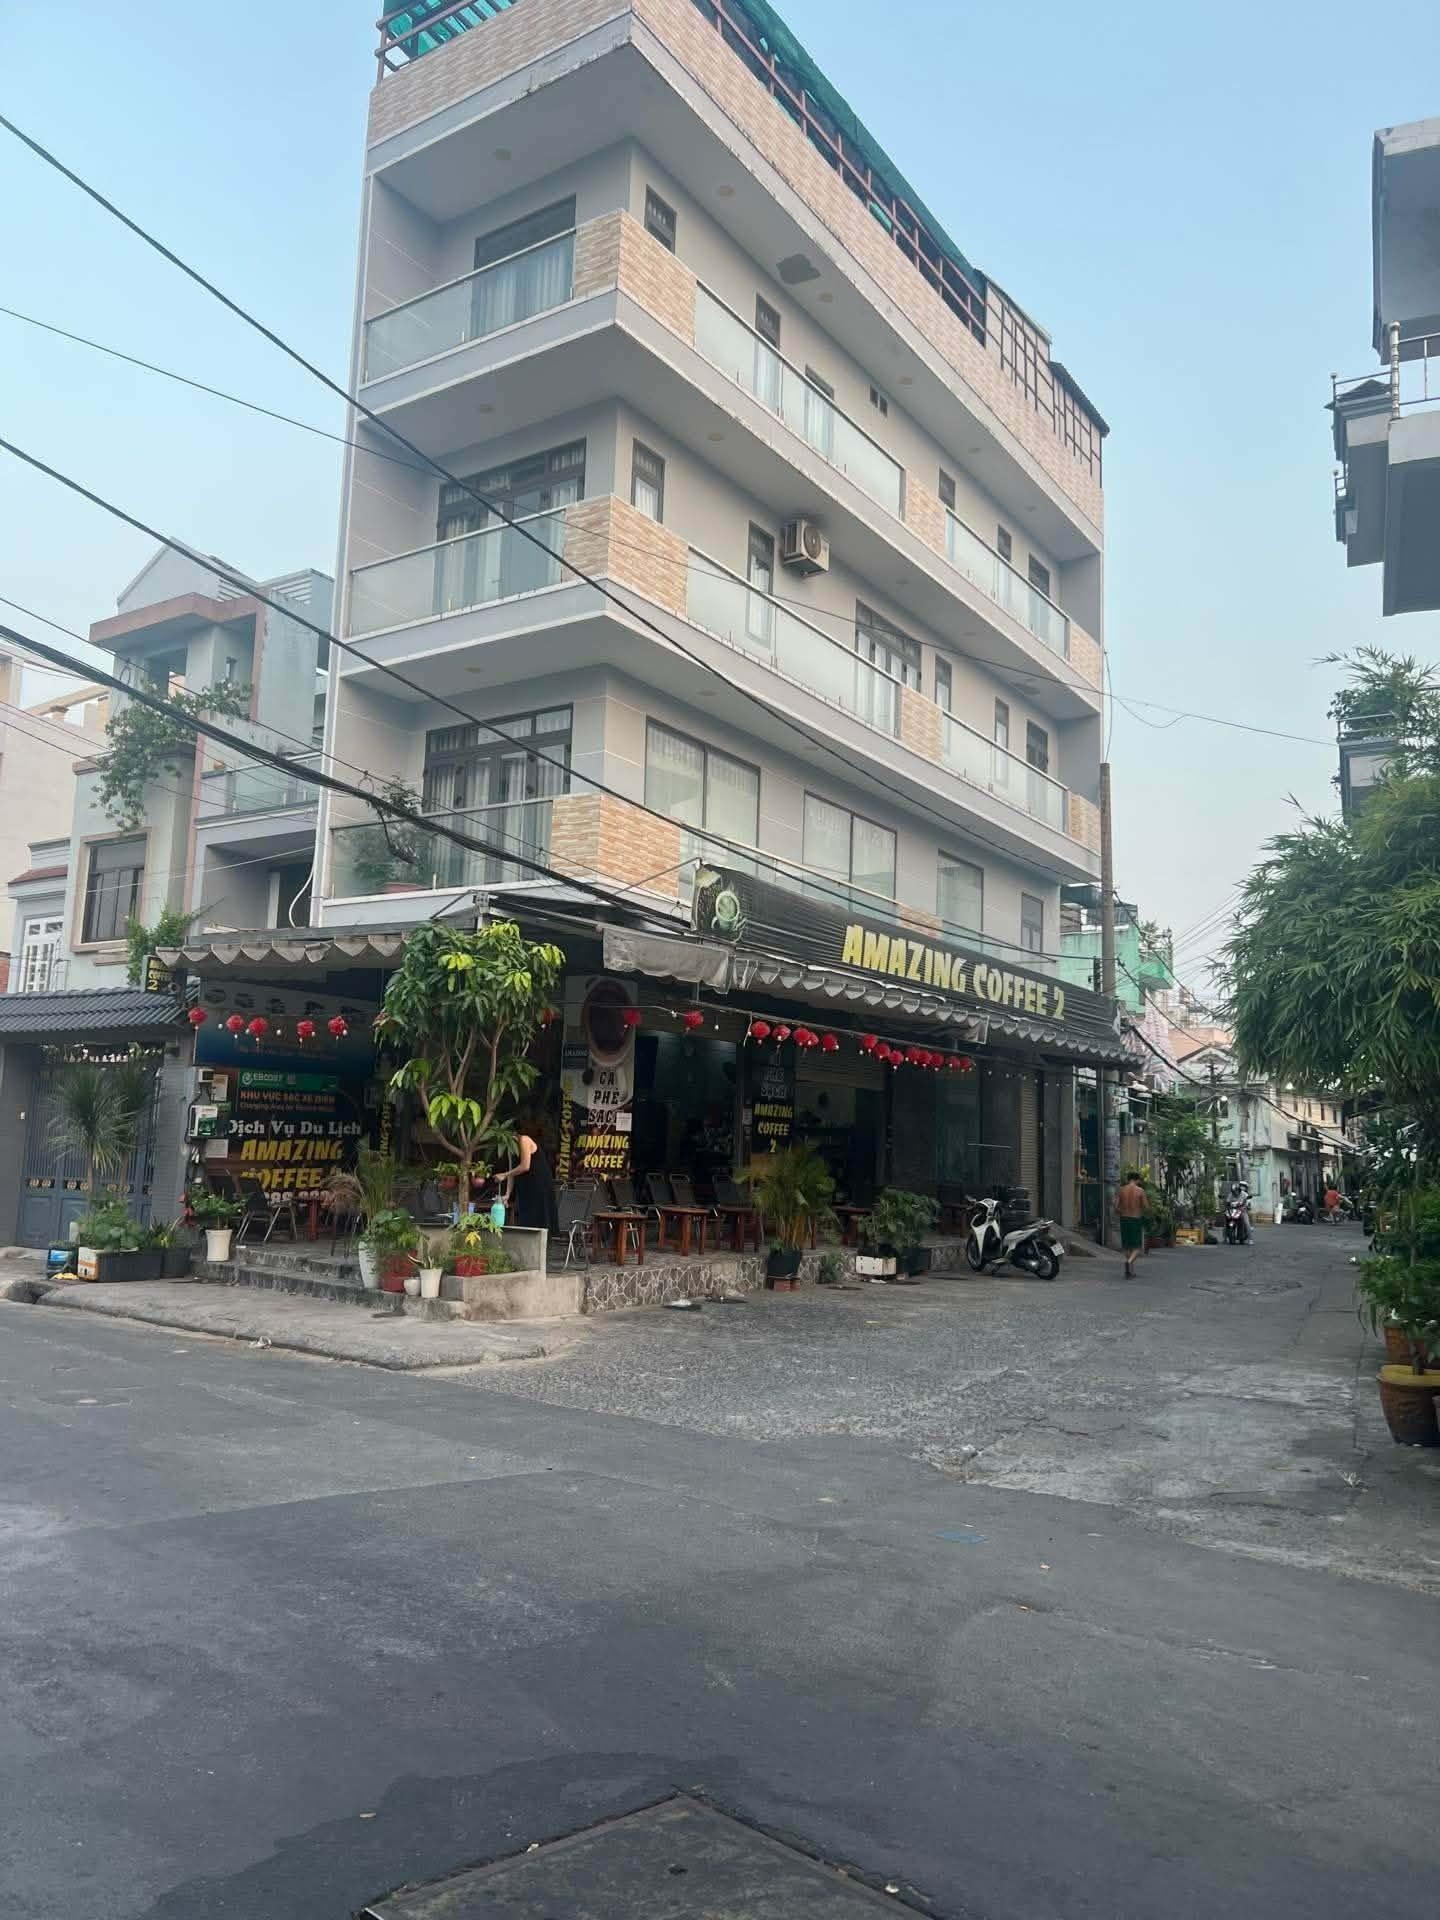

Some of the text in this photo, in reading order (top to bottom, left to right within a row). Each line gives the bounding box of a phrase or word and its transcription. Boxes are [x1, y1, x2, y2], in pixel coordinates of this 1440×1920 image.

[842, 924, 1066, 1021] AMAZING COFFEE 2
[754, 1103, 793, 1119] AMAZING
[271, 1120, 295, 1138] Vụ
[300, 1121, 323, 1135] Du
[758, 1121, 790, 1136] COFFEE
[240, 1139, 343, 1161] AMAZING
[577, 1135, 630, 1149] AMAZING
[583, 1154, 624, 1169] COFFEE
[241, 1167, 323, 1192] OFFEE
